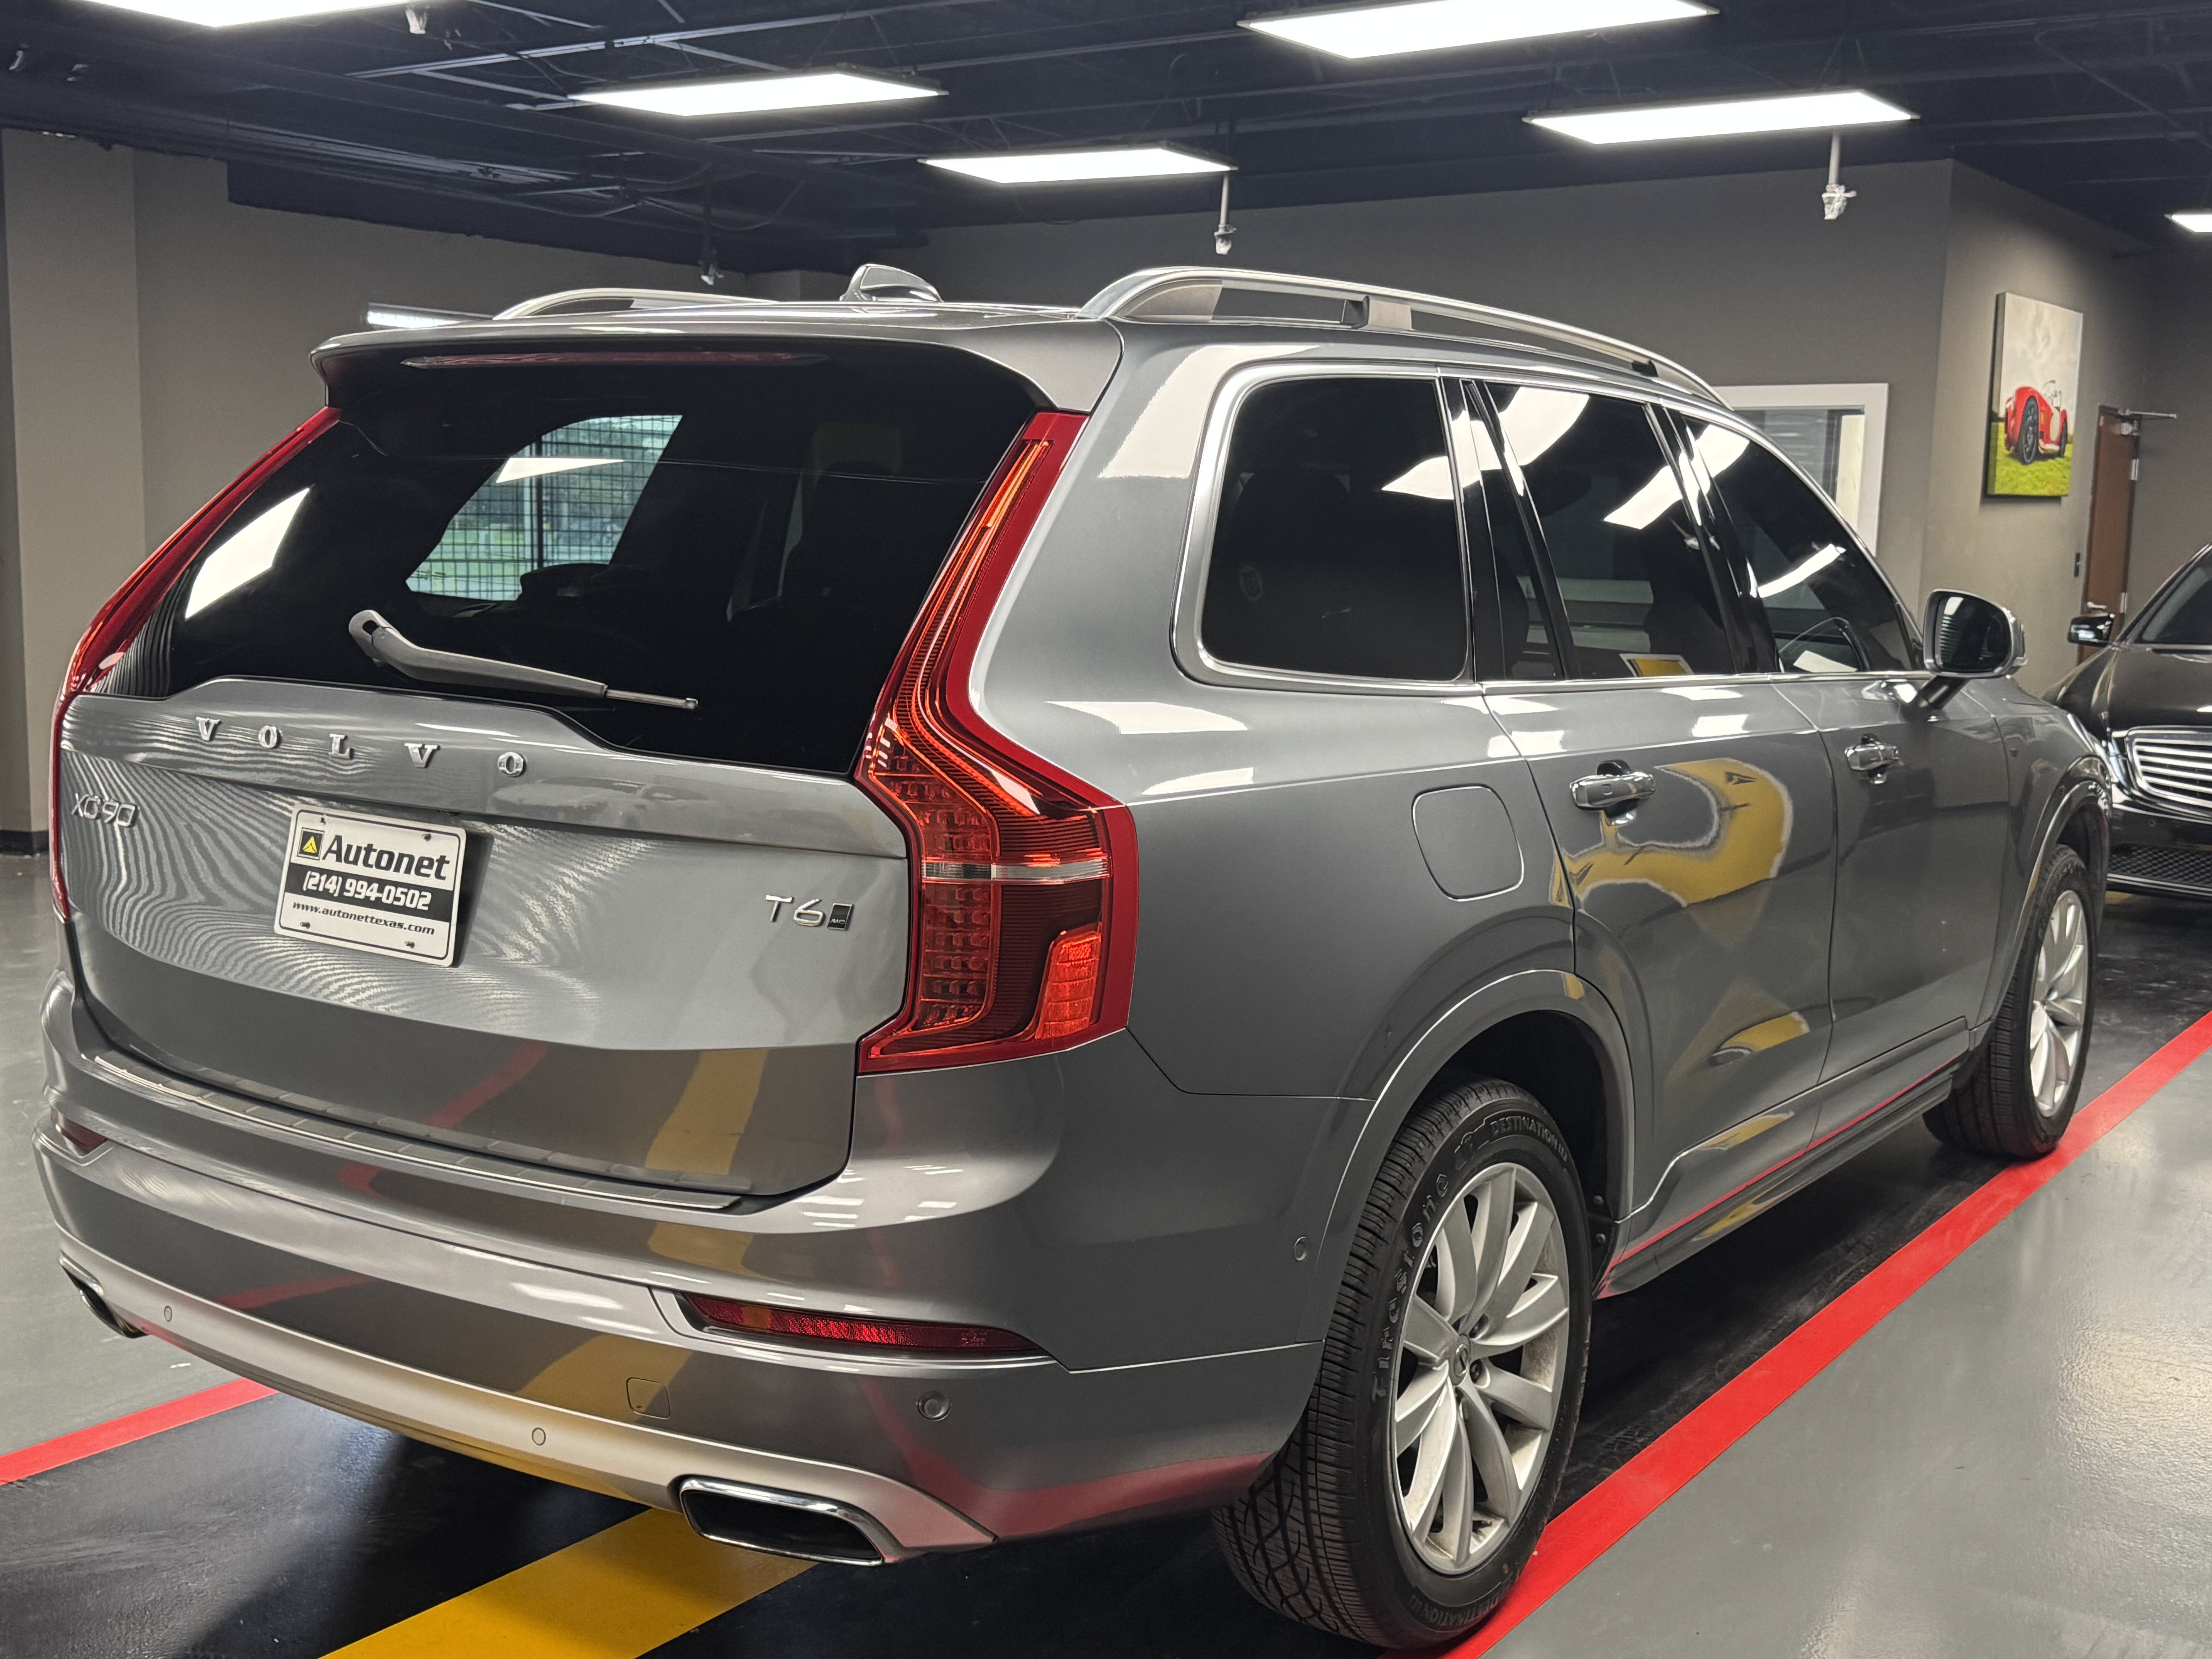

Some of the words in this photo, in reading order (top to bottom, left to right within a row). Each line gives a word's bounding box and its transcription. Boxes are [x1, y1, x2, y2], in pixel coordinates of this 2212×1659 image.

[196, 716, 525, 776] VOLVO
[71, 793, 135, 827] XC90
[322, 834, 450, 881] Autonet
[303, 871, 342, 897] (214)
[343, 878, 432, 910] 994-0502
[292, 902, 435, 935] www.autonettexas.com
[765, 895, 823, 926] T6
